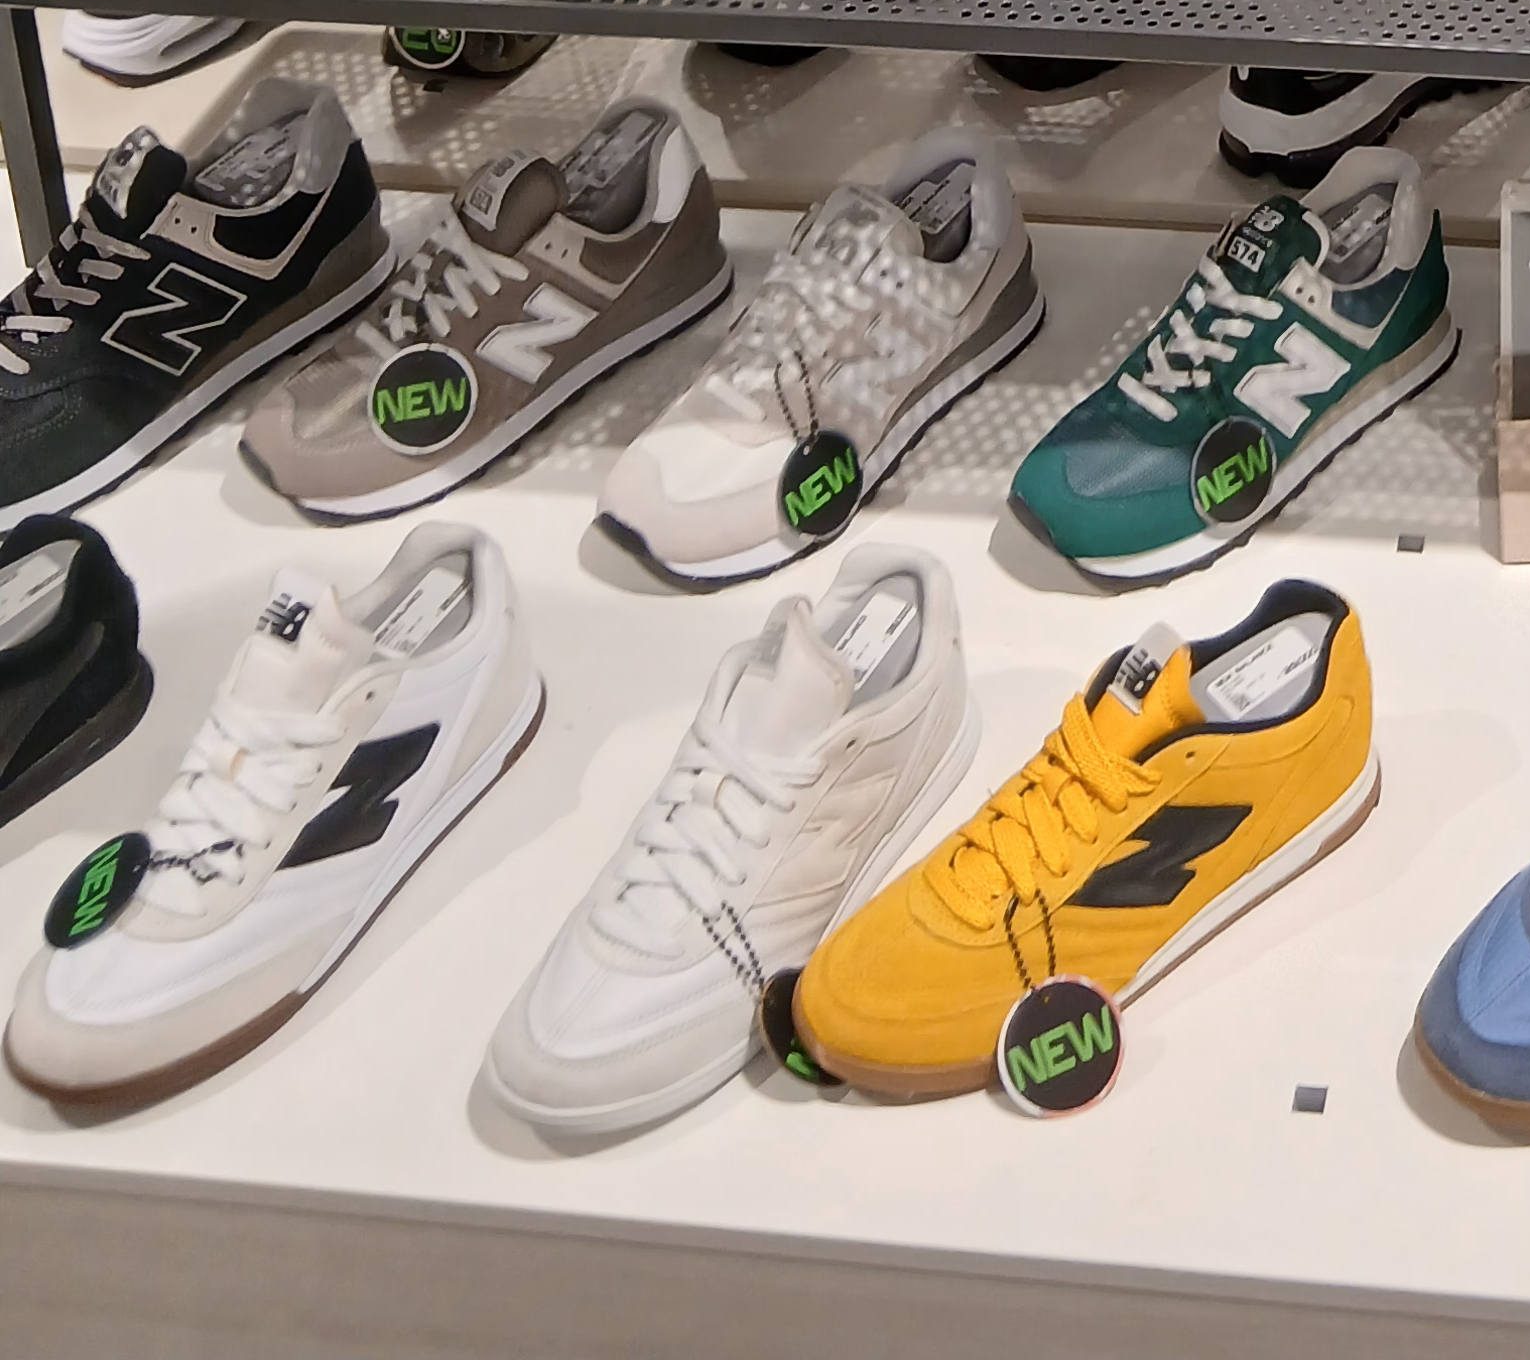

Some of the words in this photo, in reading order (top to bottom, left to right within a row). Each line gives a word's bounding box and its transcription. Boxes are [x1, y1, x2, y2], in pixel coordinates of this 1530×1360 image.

[1229, 237, 1264, 270] 574
[377, 377, 467, 426] NEW
[785, 447, 856, 527] NEW
[1196, 436, 1268, 513] NEW
[69, 840, 123, 938] NEW
[1007, 1005, 1114, 1093] NEW
